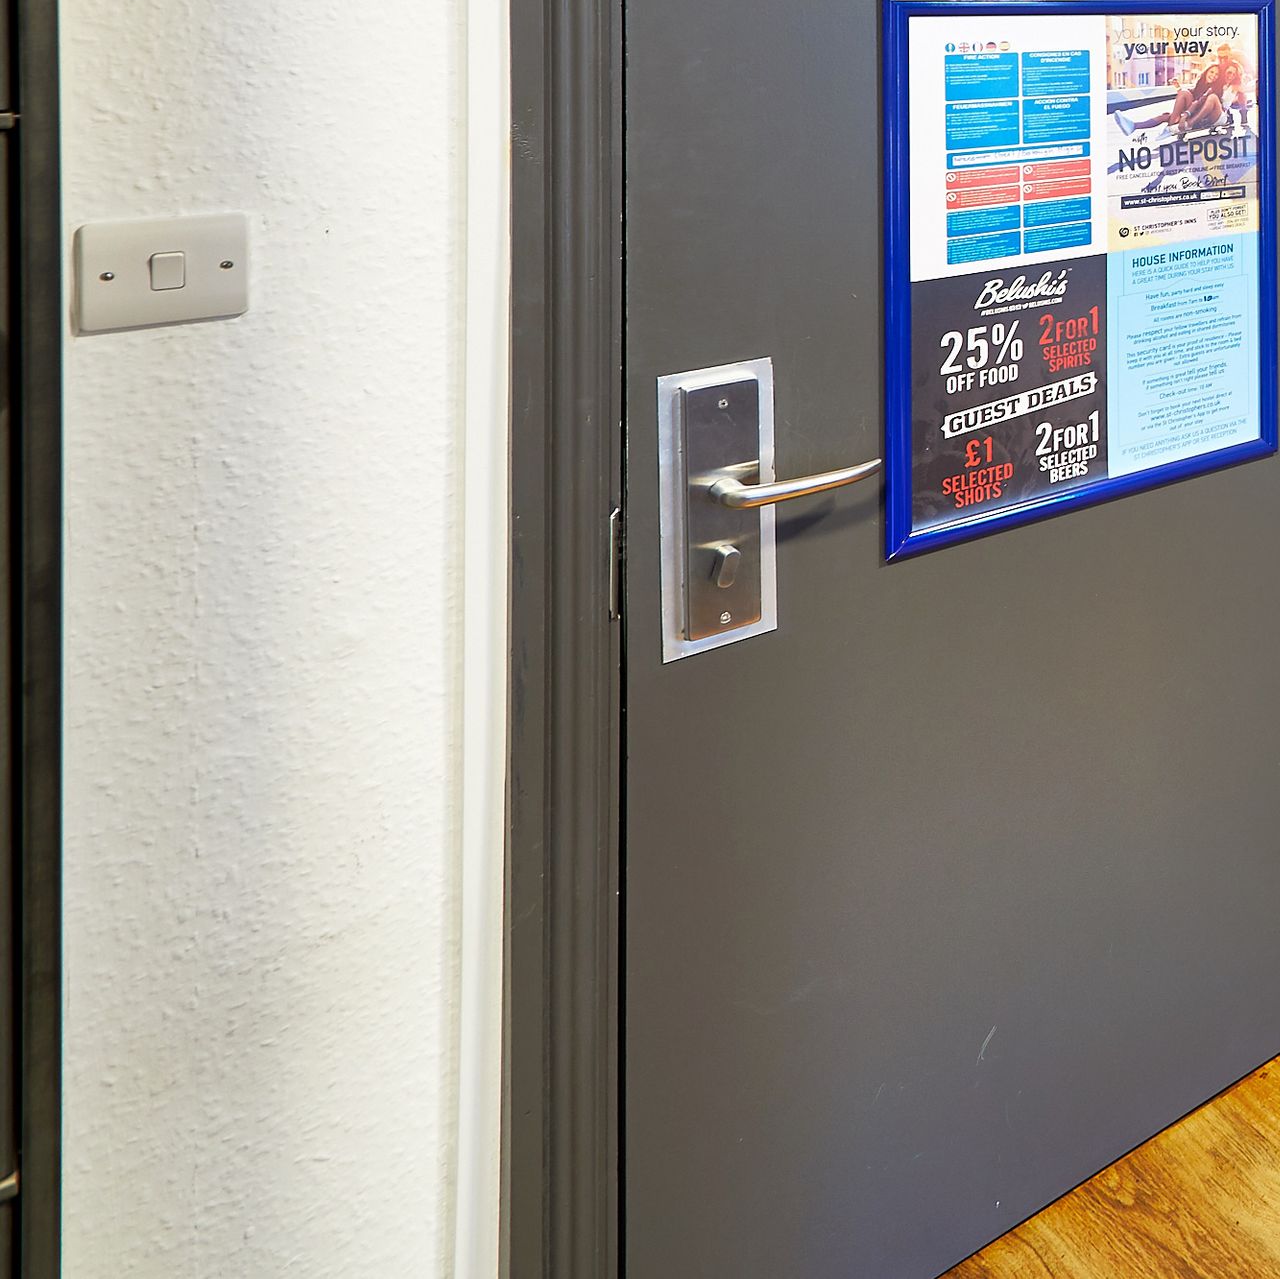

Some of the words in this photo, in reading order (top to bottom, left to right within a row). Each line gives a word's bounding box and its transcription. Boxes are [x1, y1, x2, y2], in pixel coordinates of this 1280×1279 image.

[1174, 26, 1202, 40] your
[1206, 26, 1239, 39] story.
[1124, 42, 1169, 60] your
[1173, 41, 1212, 57] way.
[1118, 146, 1151, 172] NO
[1160, 135, 1251, 167] DEPOSIT
[1180, 176, 1201, 189] Book
[1203, 174, 1228, 188] Direct
[1132, 254, 1165, 267] HOUSE
[1168, 243, 1233, 262] INFORMATION
[1168, 271, 1187, 279] DURING
[974, 270, 1068, 309] Belushi's
[1150, 301, 1176, 311] Breakfast
[1182, 306, 1216, 318] non-smoking
[1142, 329, 1162, 337] respect
[940, 320, 1023, 375] 25%
[1043, 338, 1097, 360] SELECTED
[1136, 348, 1157, 357] security
[1049, 353, 1091, 372] SPIRITS
[946, 372, 974, 394] OFF
[980, 364, 1018, 388] FOOD
[950, 398, 1020, 433] GUEST
[1028, 376, 1091, 411] DEALS
[1159, 388, 1186, 399] Check-out
[965, 436, 993, 468] £1
[1039, 444, 1097, 472] SELECTED
[943, 463, 1014, 495] SELECTED
[1050, 461, 1088, 484] BEERS
[955, 481, 1002, 508] SHOTS
